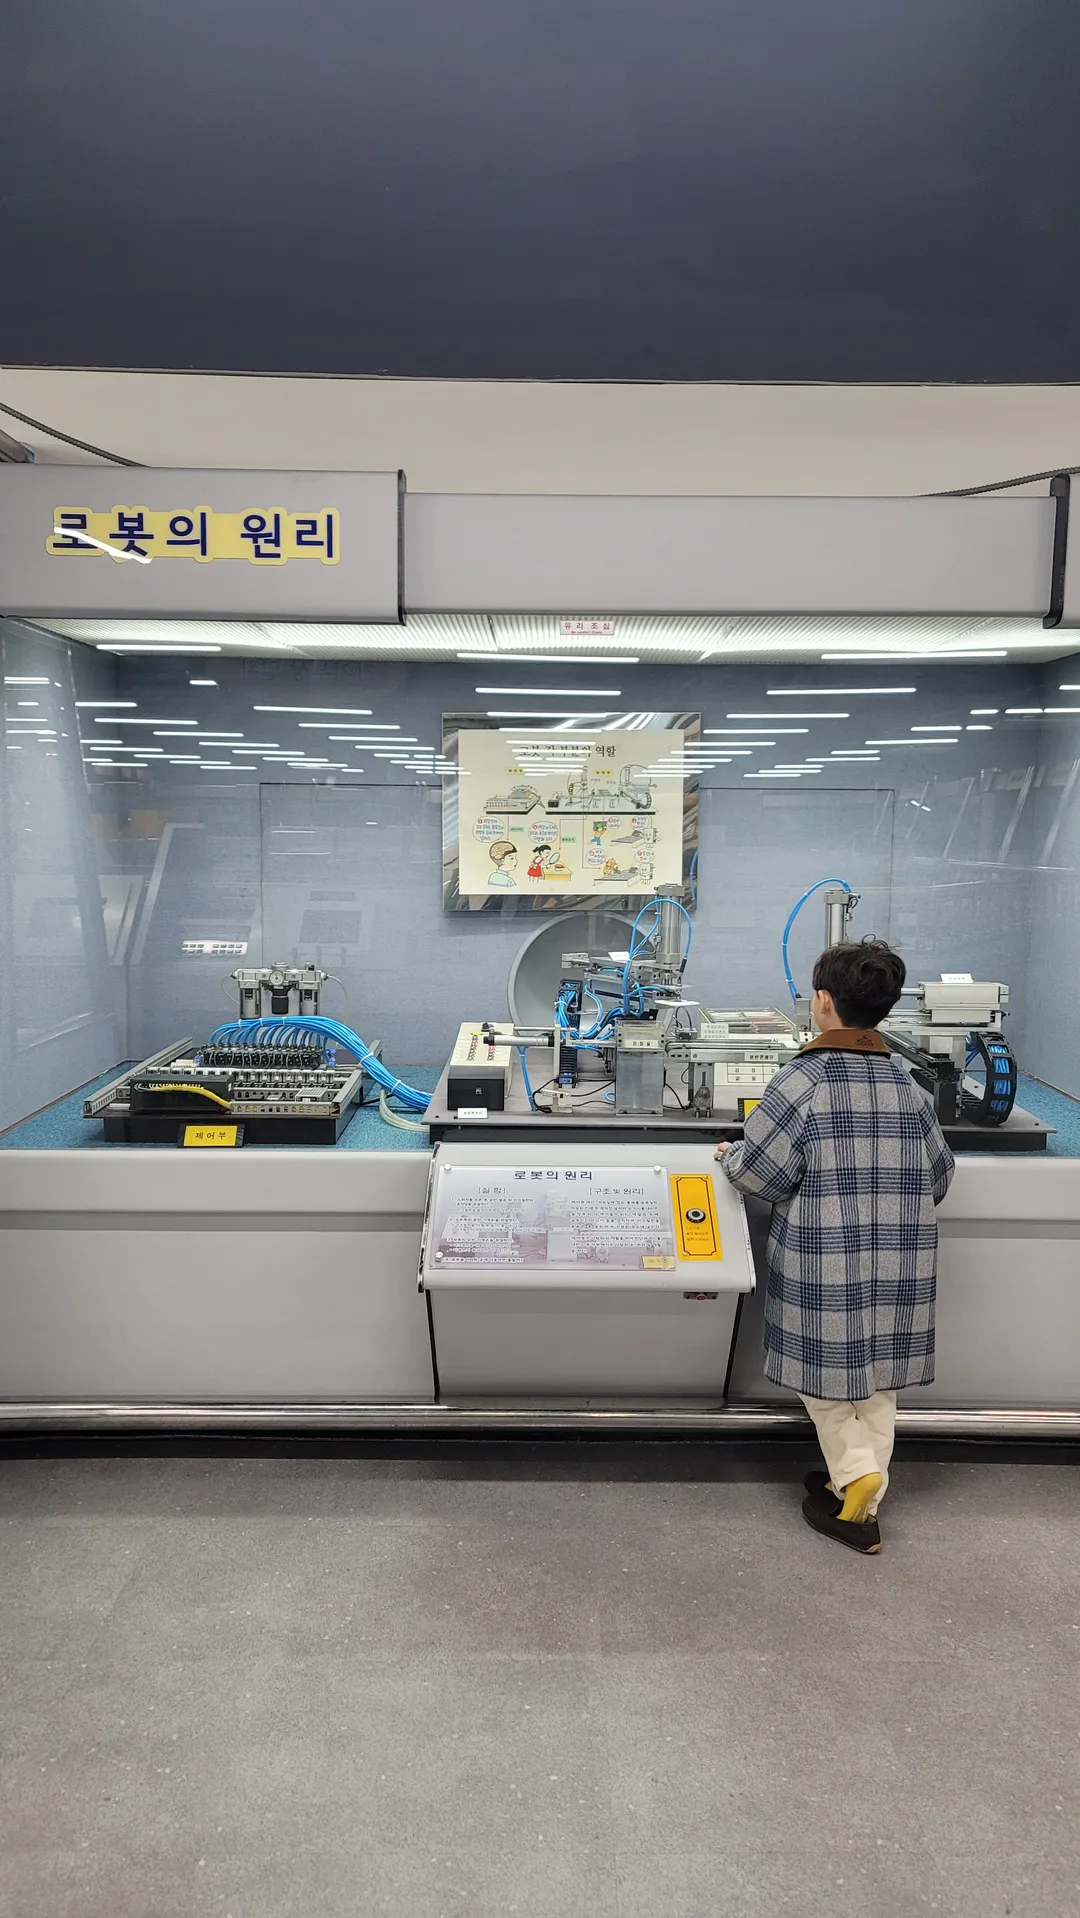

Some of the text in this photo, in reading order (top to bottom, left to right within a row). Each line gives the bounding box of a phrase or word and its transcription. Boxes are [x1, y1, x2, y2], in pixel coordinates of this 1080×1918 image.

[52, 511, 333, 558] 로봇의 원리
[564, 621, 610, 630] 유리 조심
[595, 745, 616, 757] 역할
[195, 1131, 227, 1140] 제어부
[514, 1170, 593, 1181] 로봇의 원리
